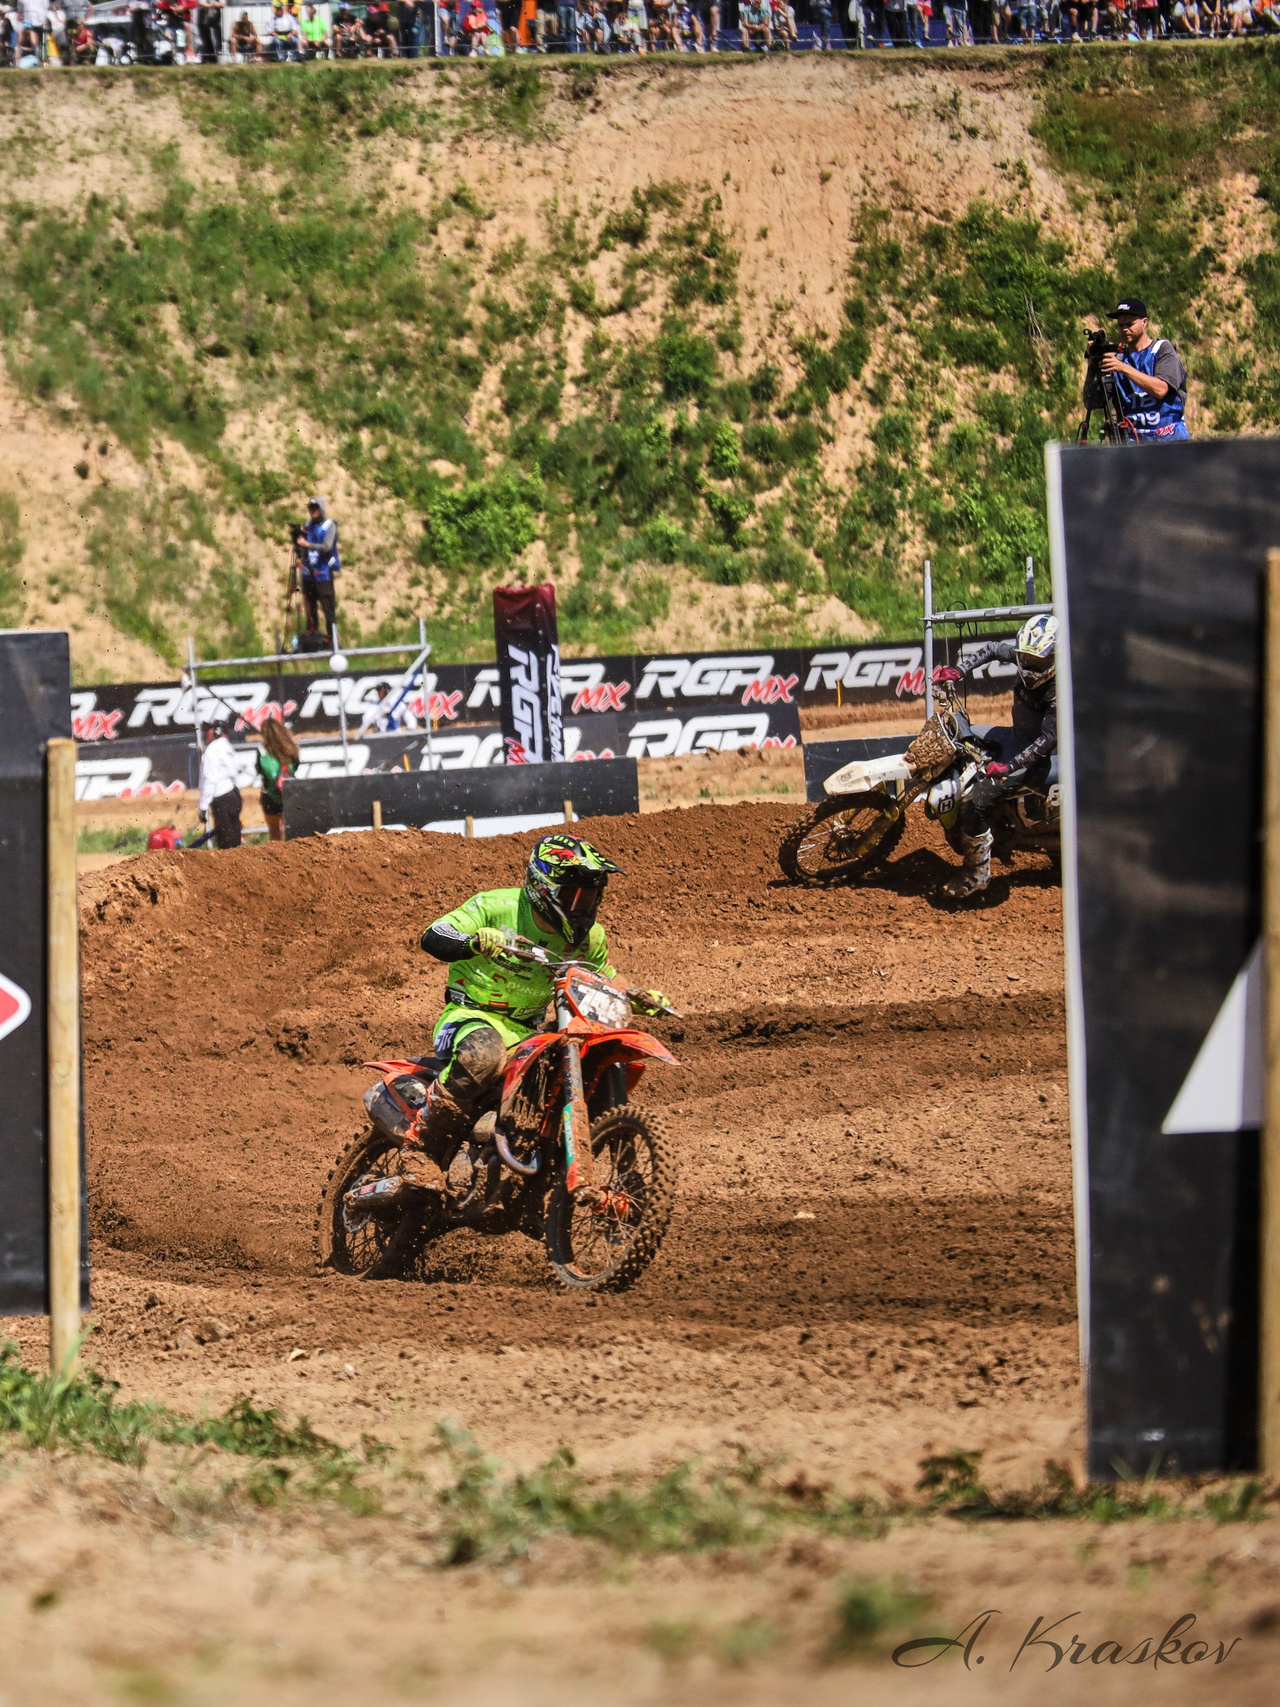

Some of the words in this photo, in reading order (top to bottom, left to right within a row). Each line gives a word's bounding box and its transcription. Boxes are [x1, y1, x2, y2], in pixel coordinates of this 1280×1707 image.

[635, 656, 775, 698] RGP
[741, 673, 799, 706] MX
[804, 648, 923, 691] RGP
[127, 682, 270, 728] RGP
[408, 690, 464, 720] MX
[507, 644, 544, 764] RGP
[572, 681, 631, 714] MX
[627, 713, 770, 759] RGP
